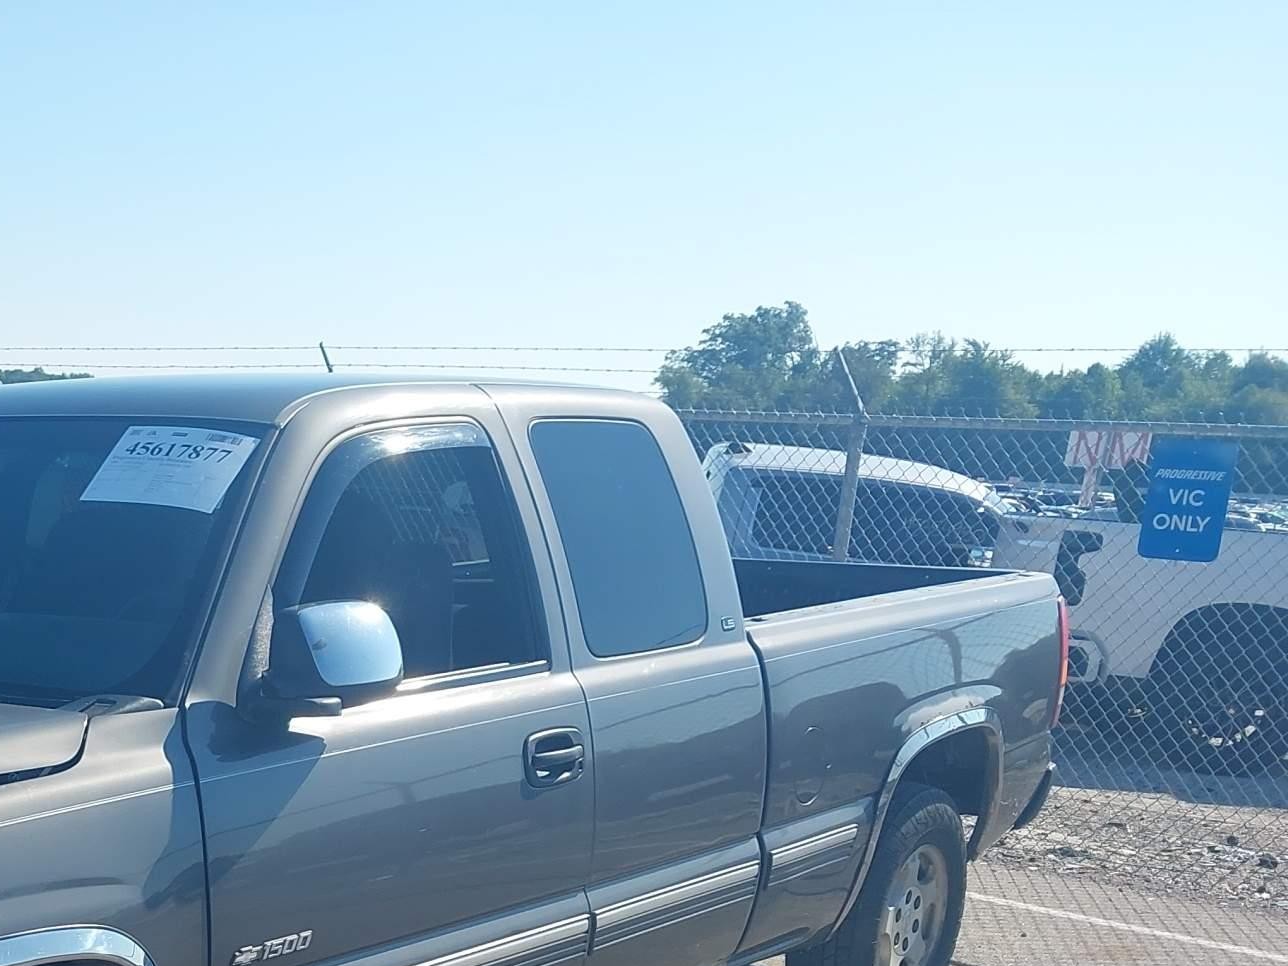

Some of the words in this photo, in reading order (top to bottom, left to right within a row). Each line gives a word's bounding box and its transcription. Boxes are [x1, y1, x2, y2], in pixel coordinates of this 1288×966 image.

[125, 441, 233, 464] 45617877
[1155, 468, 1227, 481] PROGRESSIVE
[1169, 488, 1206, 507] VIC
[1153, 513, 1211, 533] ONLY
[262, 930, 312, 960] 1500
